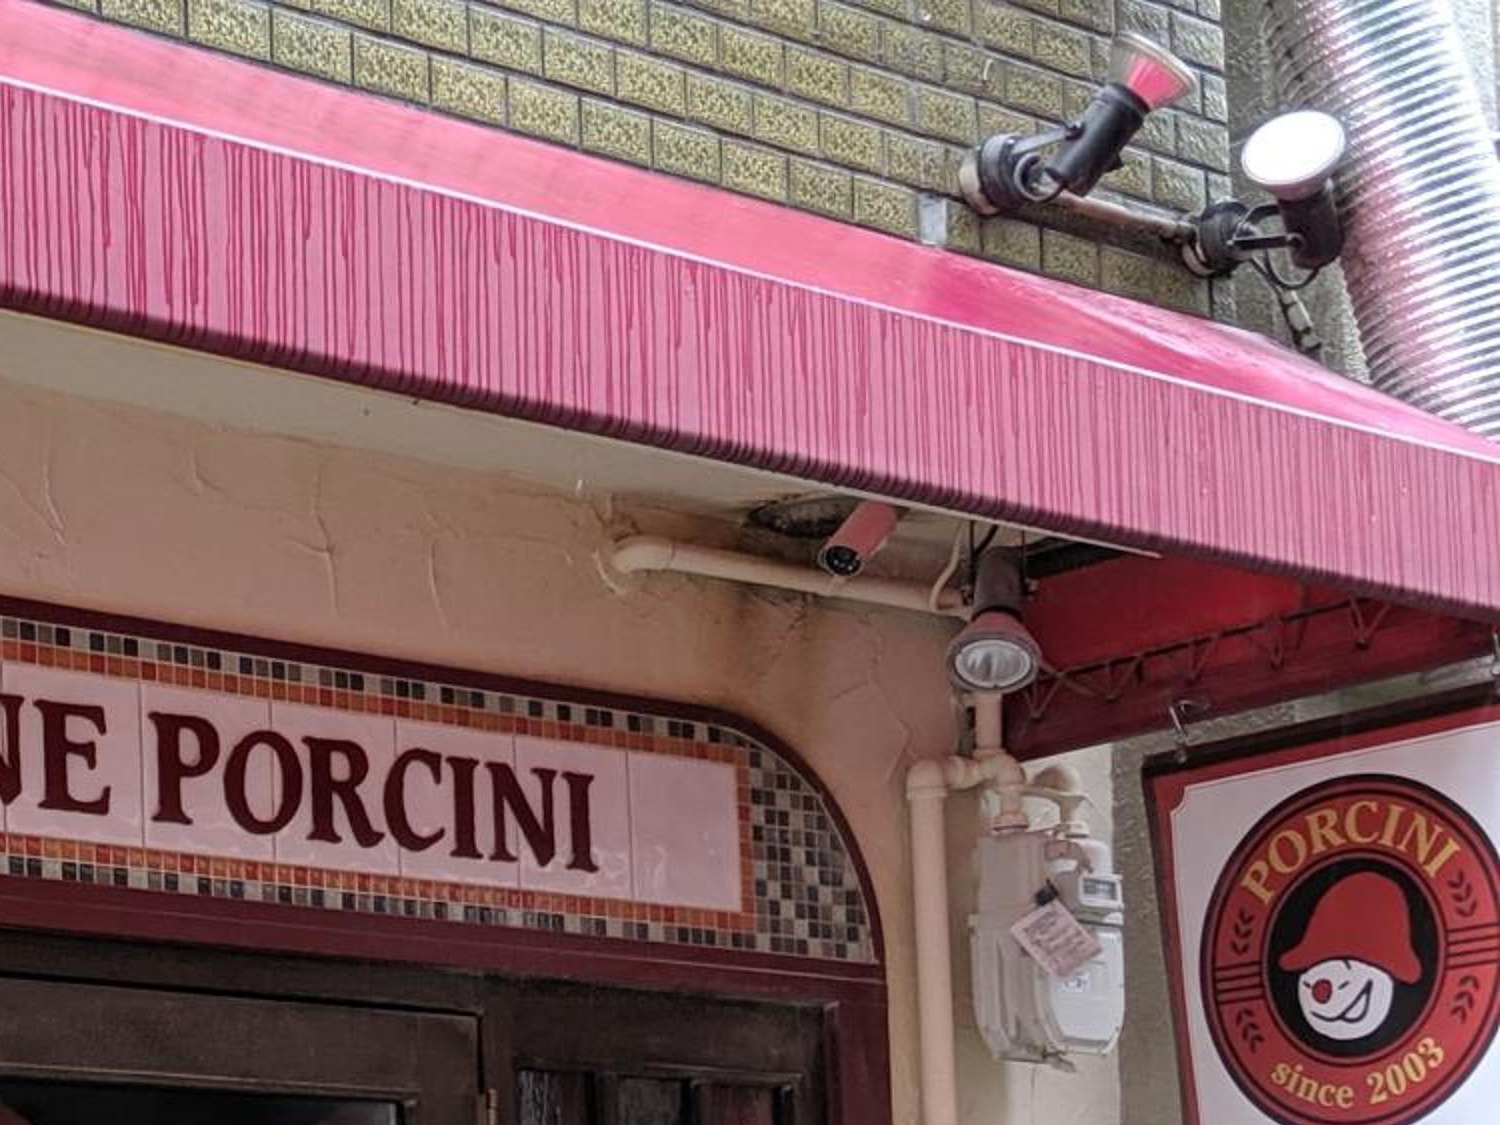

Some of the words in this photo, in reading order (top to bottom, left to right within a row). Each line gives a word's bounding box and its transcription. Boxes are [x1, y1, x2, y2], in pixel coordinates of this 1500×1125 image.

[148, 711, 598, 872] PORCINI
[1241, 800, 1459, 904] PORCINI
[1271, 1061, 1353, 1108] since
[1366, 1036, 1445, 1104] 2003
